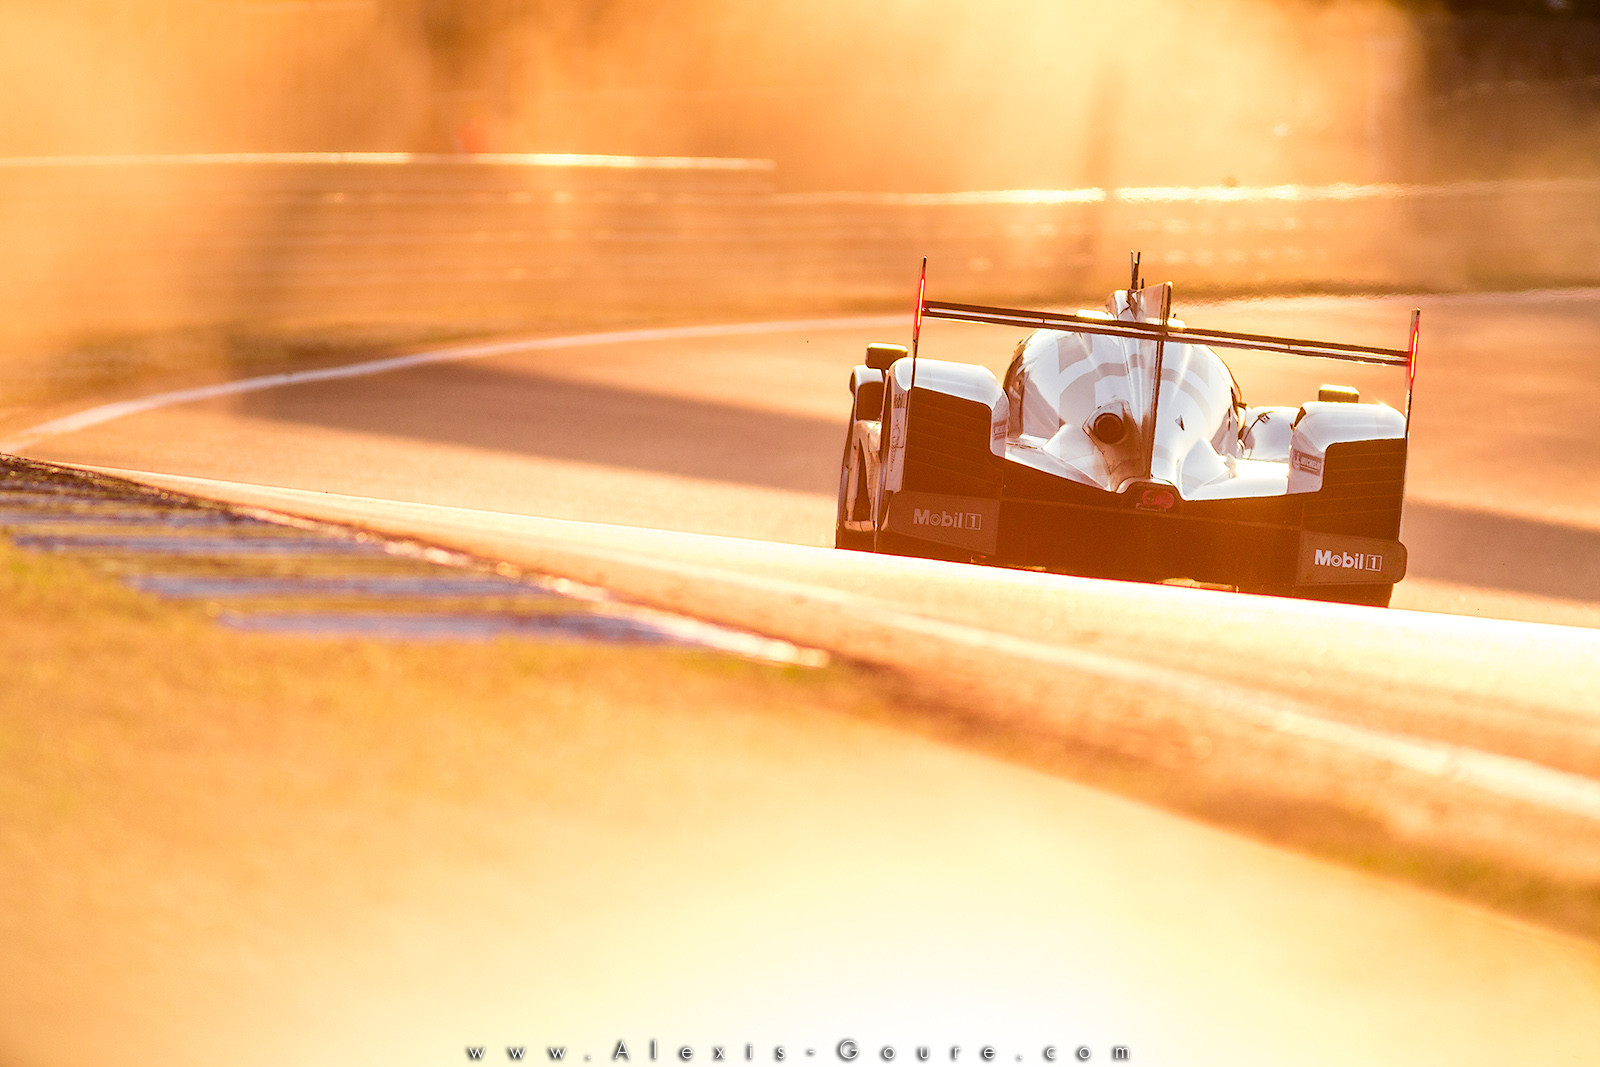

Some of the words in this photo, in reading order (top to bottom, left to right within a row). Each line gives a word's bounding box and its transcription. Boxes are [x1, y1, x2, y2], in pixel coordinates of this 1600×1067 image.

[913, 508, 963, 529] Mobil
[966, 513, 982, 530] 1
[1314, 549, 1363, 570] Mobil
[1366, 555, 1382, 571] 1
